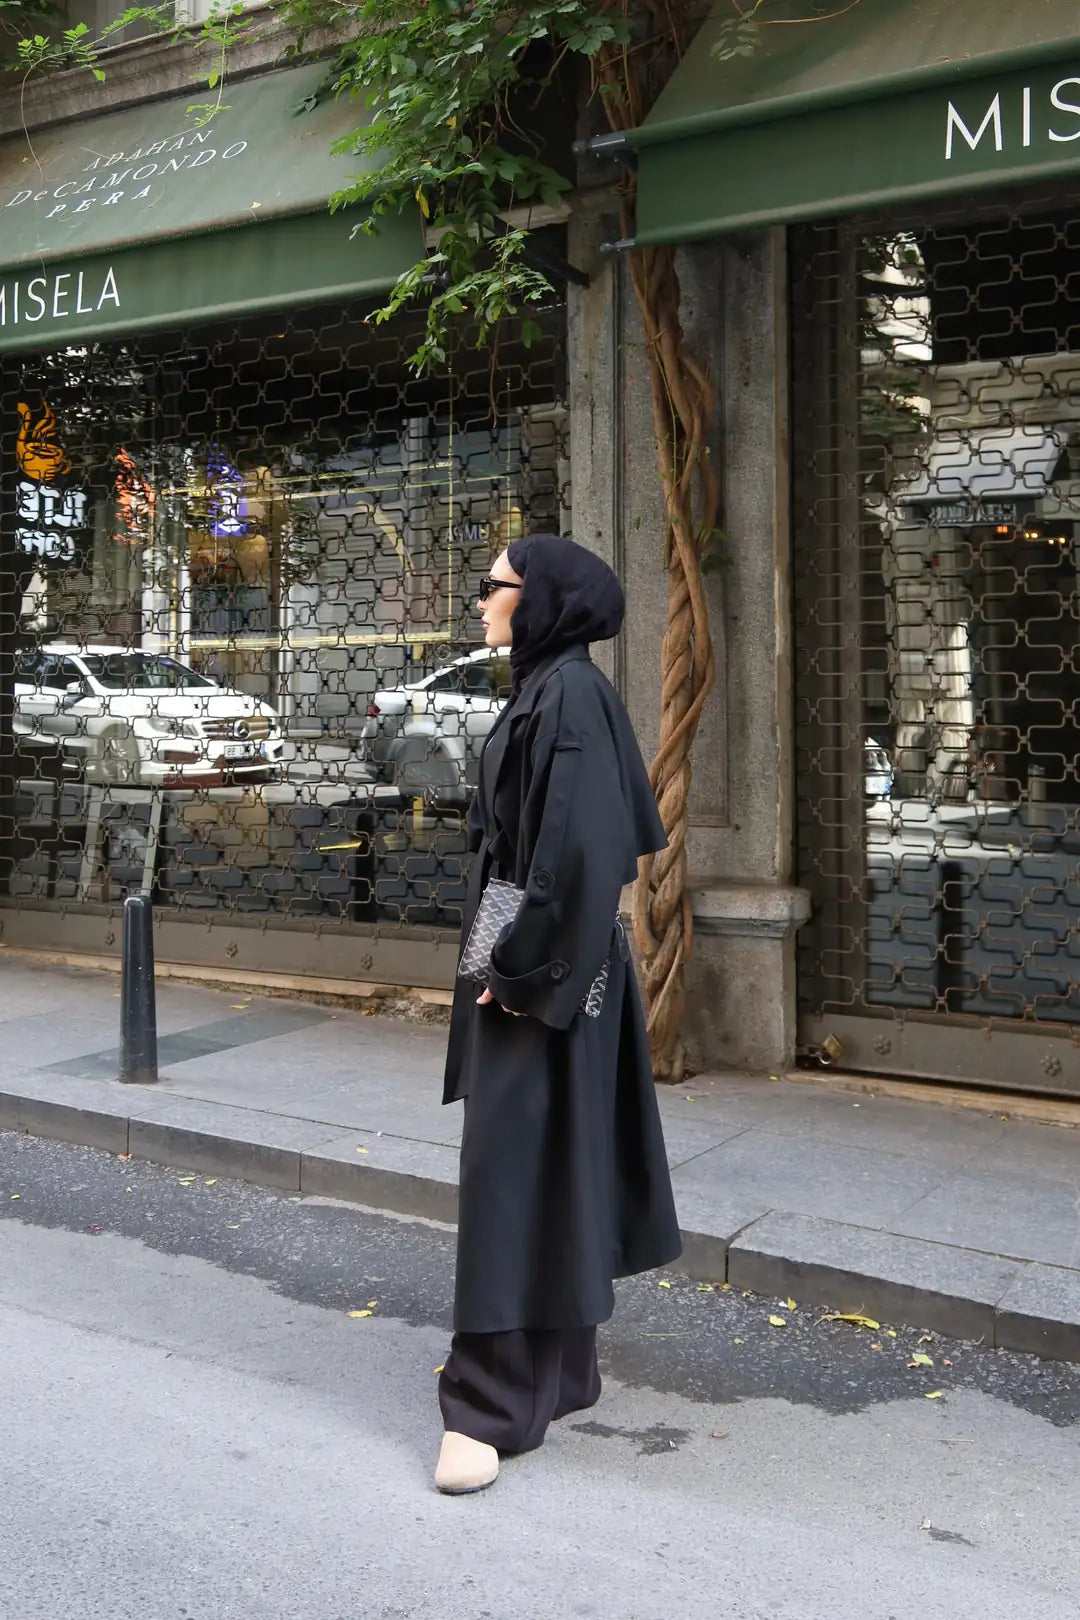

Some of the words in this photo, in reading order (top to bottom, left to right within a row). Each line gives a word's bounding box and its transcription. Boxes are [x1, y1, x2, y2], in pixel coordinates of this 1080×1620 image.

[82, 129, 215, 172] ADAHAN
[44, 184, 153, 219] PERA
[0, 266, 121, 326] ISELA
